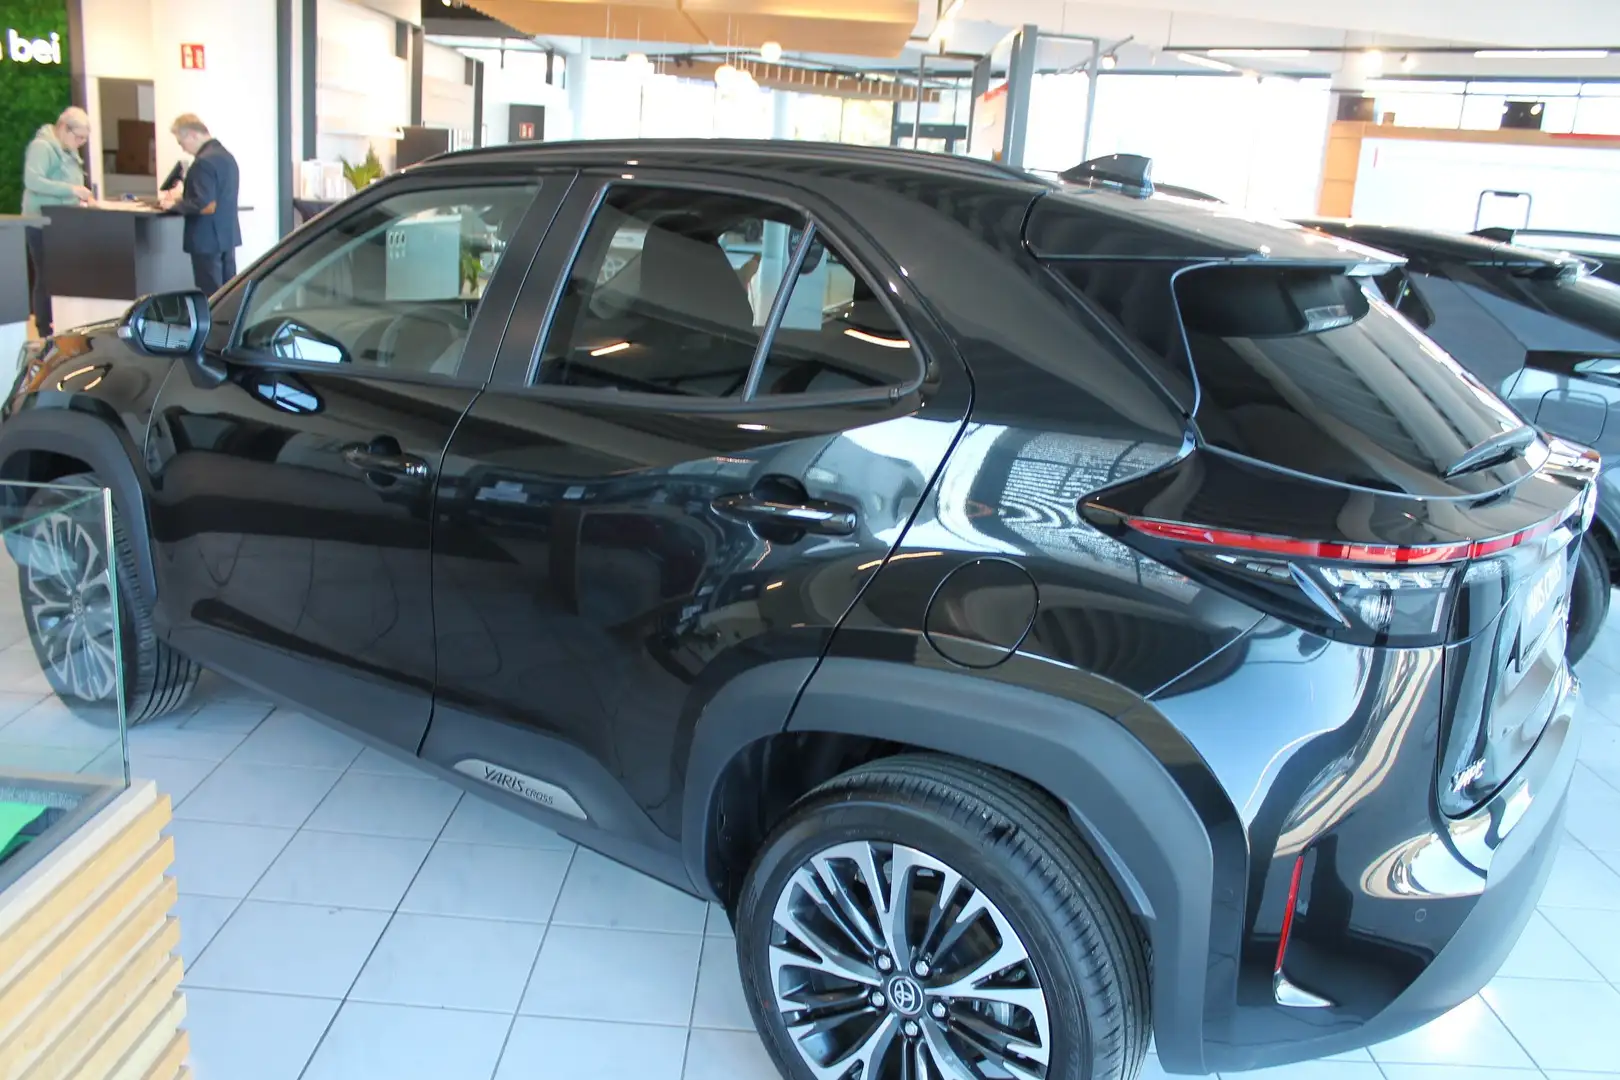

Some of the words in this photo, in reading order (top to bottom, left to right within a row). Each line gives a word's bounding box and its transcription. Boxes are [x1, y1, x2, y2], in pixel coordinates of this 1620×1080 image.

[8, 28, 61, 64] bei
[485, 766, 525, 792] YARIS
[526, 788, 554, 804] CROSS
